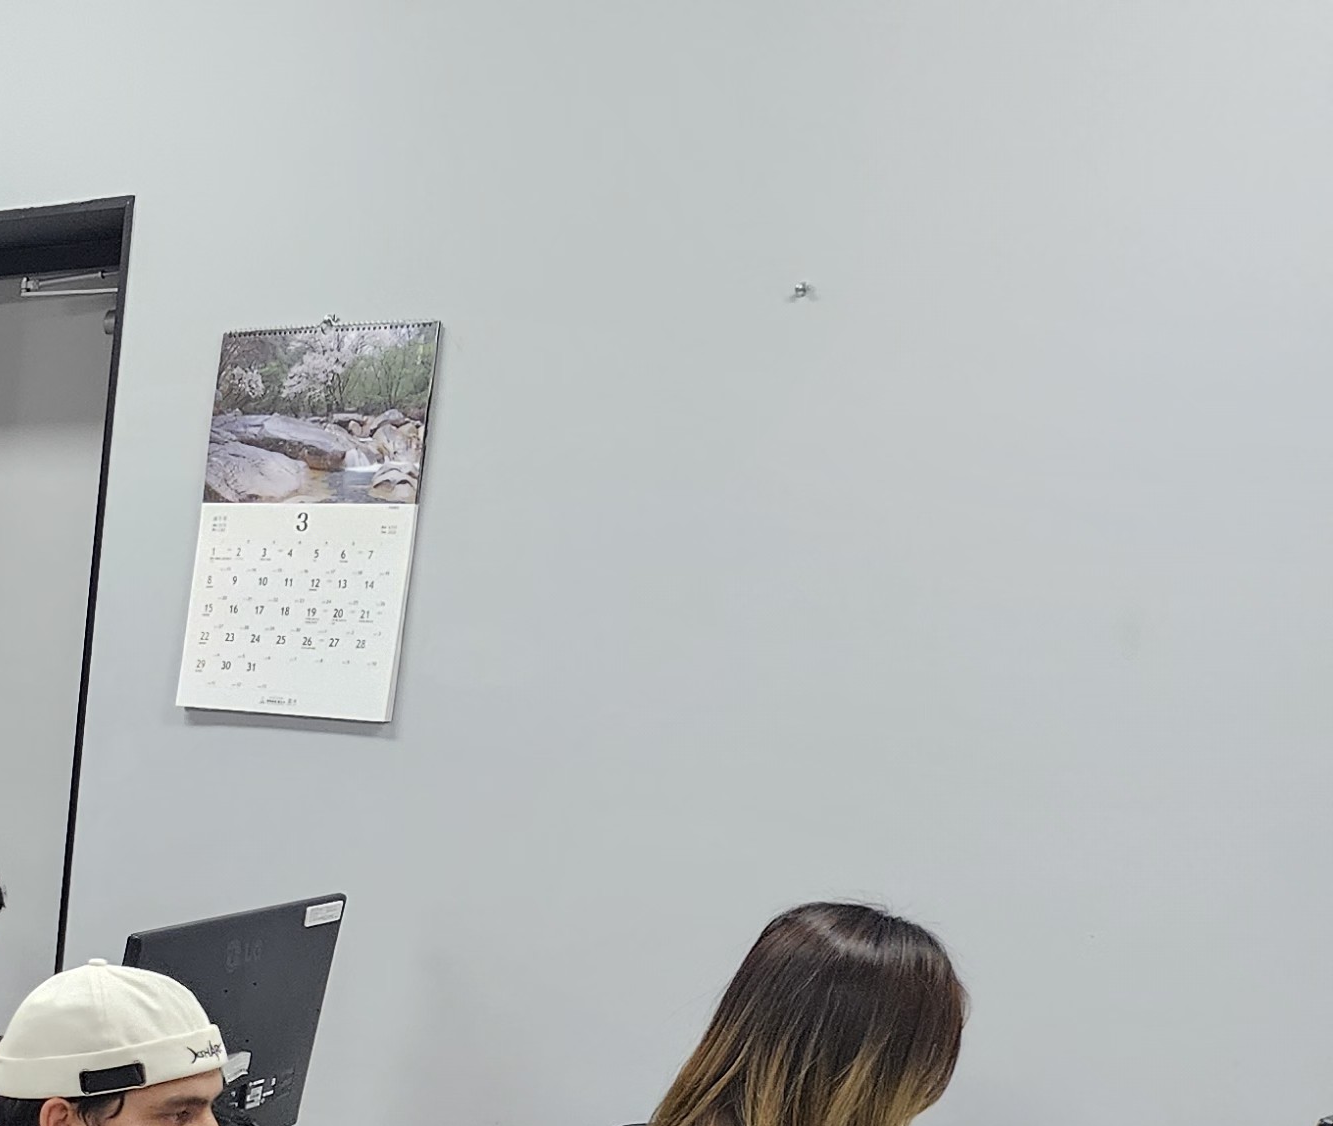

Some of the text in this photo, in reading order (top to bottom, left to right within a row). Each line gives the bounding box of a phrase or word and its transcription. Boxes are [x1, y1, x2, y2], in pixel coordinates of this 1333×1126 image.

[295, 512, 309, 532] 3
[258, 576, 269, 587] 10
[284, 577, 294, 587] 11
[310, 578, 321, 588] 12
[338, 578, 348, 589] 13
[364, 580, 375, 589] 14
[204, 603, 370, 620] 15 16 17 18 19 20 21
[199, 631, 366, 649] 22 23 24 25 26 27 28
[196, 658, 257, 672] 29 30 31
